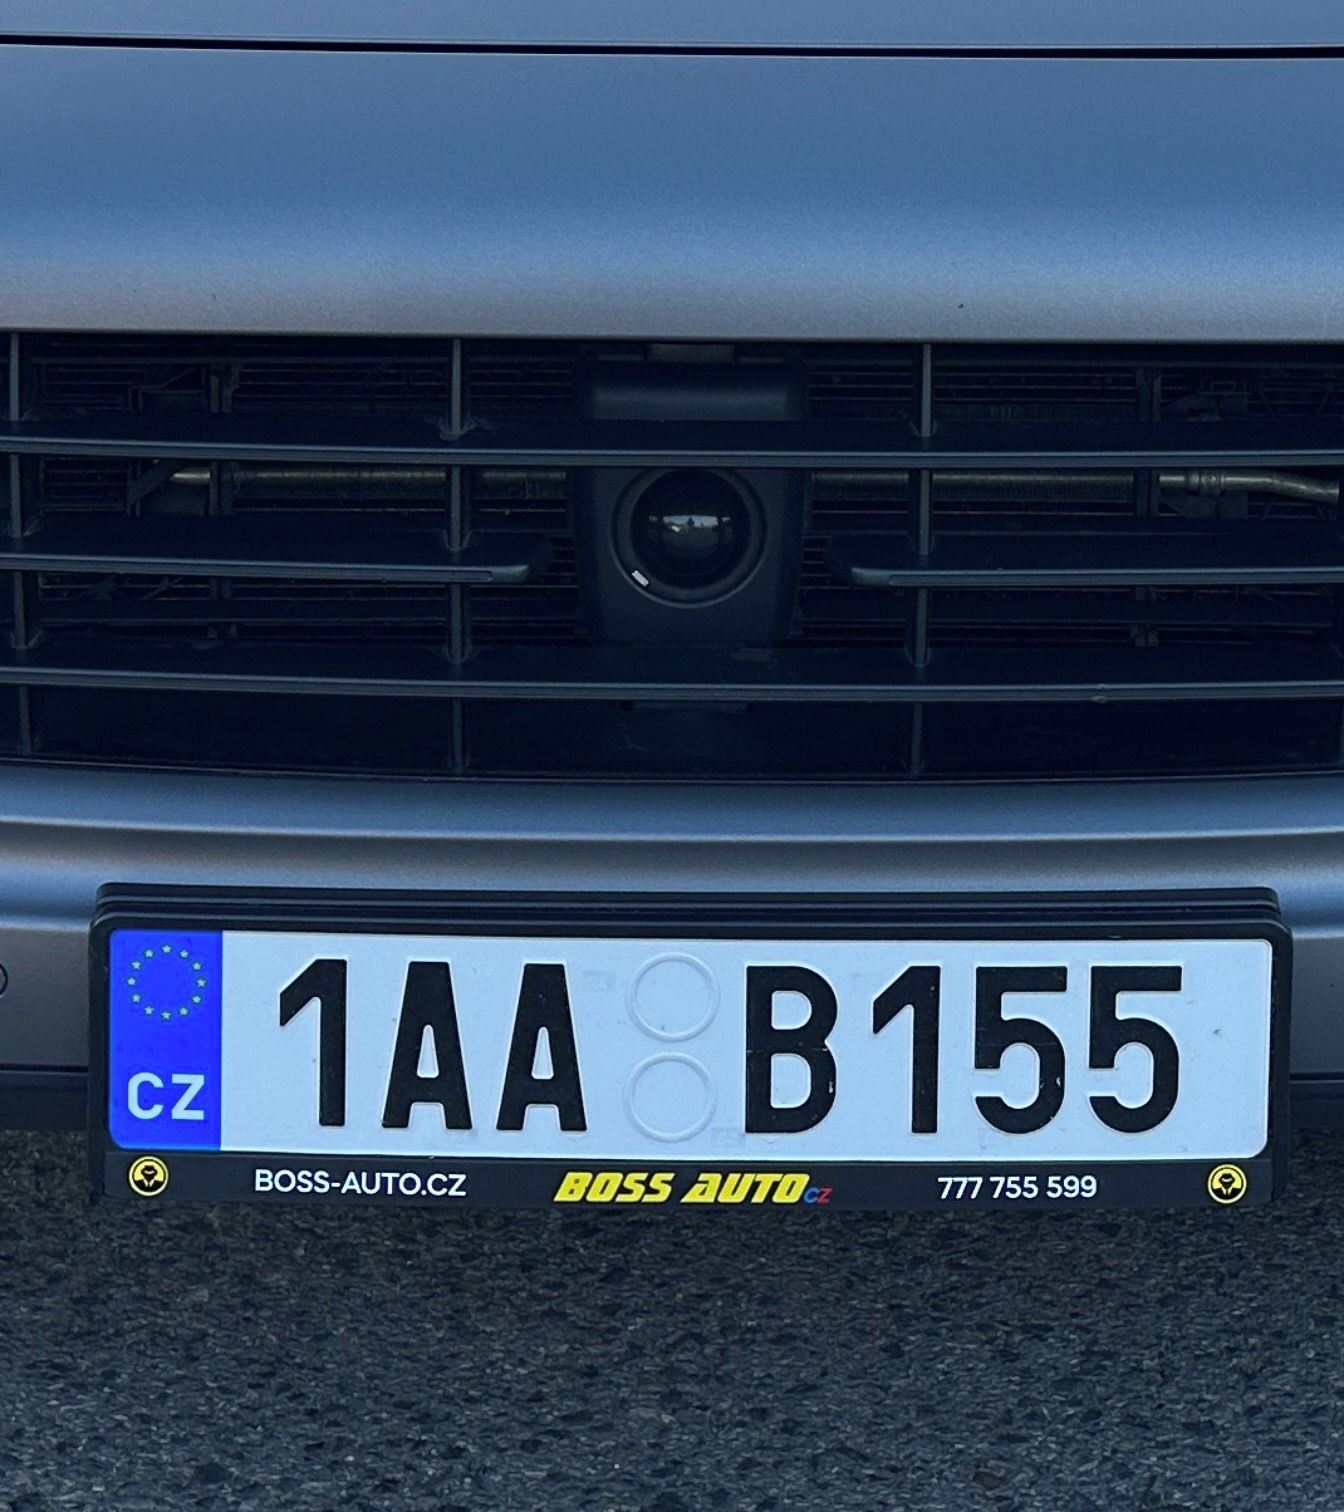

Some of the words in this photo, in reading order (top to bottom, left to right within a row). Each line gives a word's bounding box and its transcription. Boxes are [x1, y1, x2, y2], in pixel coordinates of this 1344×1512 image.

[279, 959, 588, 1132] 1AA
[744, 965, 1183, 1134] B155
[125, 1072, 206, 1120] CZ
[255, 1169, 467, 1197] BOSS-AUTO.CZ
[554, 1172, 673, 1203] BOSS
[938, 1176, 982, 1200] 777
[989, 1175, 1039, 1200] 755
[1046, 1175, 1098, 1200] 599
